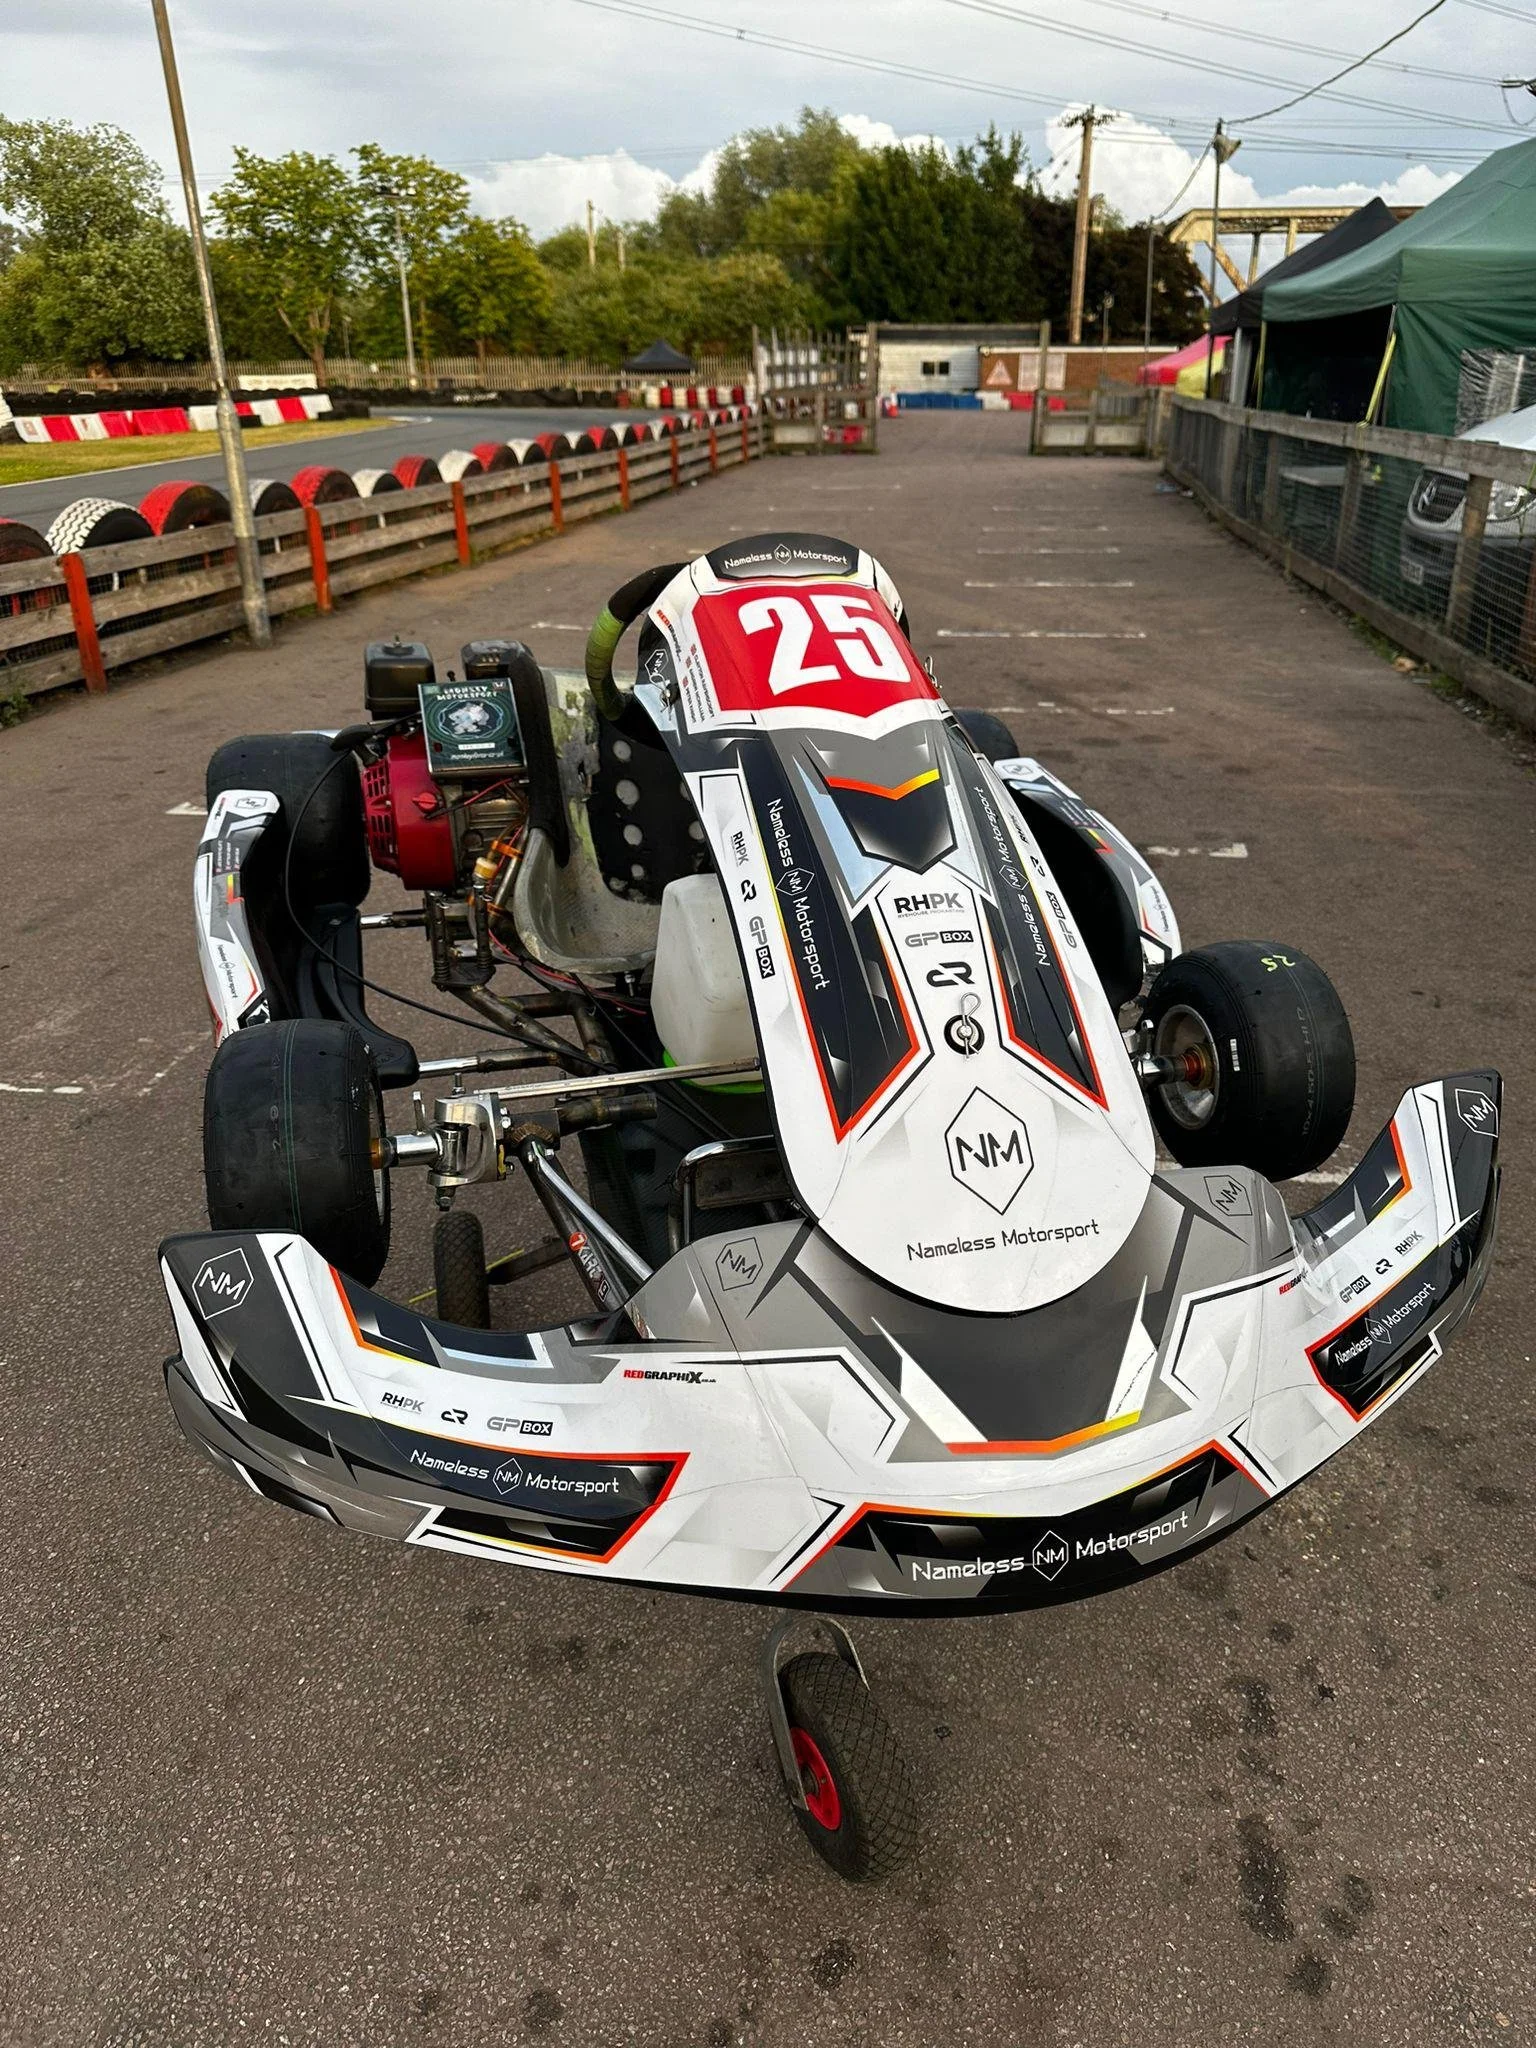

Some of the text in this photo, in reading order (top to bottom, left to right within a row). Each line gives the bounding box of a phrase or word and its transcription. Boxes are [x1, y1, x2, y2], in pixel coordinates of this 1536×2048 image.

[724, 553, 773, 570] Nameless
[793, 549, 848, 566] Motorsport
[737, 594, 911, 697] 25
[973, 786, 1013, 863] Motorsport
[732, 831, 749, 866] RHPK
[767, 798, 831, 990] Nameless NM Motorsport
[893, 892, 964, 914] RHPK
[1018, 893, 1051, 966] Nameless
[1463, 1097, 1494, 1128] NM
[955, 1129, 1024, 1172] NM
[1215, 1180, 1242, 1211] NM
[906, 1218, 1100, 1261] Nameless Motorsport
[1394, 1230, 1423, 1255] RHPK
[199, 1266, 246, 1300] NM
[721, 1248, 757, 1279] NM
[1334, 1282, 1436, 1366] Nameless NM Motorsport
[382, 1391, 425, 1412] RHPK
[409, 1449, 619, 1497] Nameless NM Motorsport
[912, 1511, 1188, 1582] Nameless NM Motorsport
